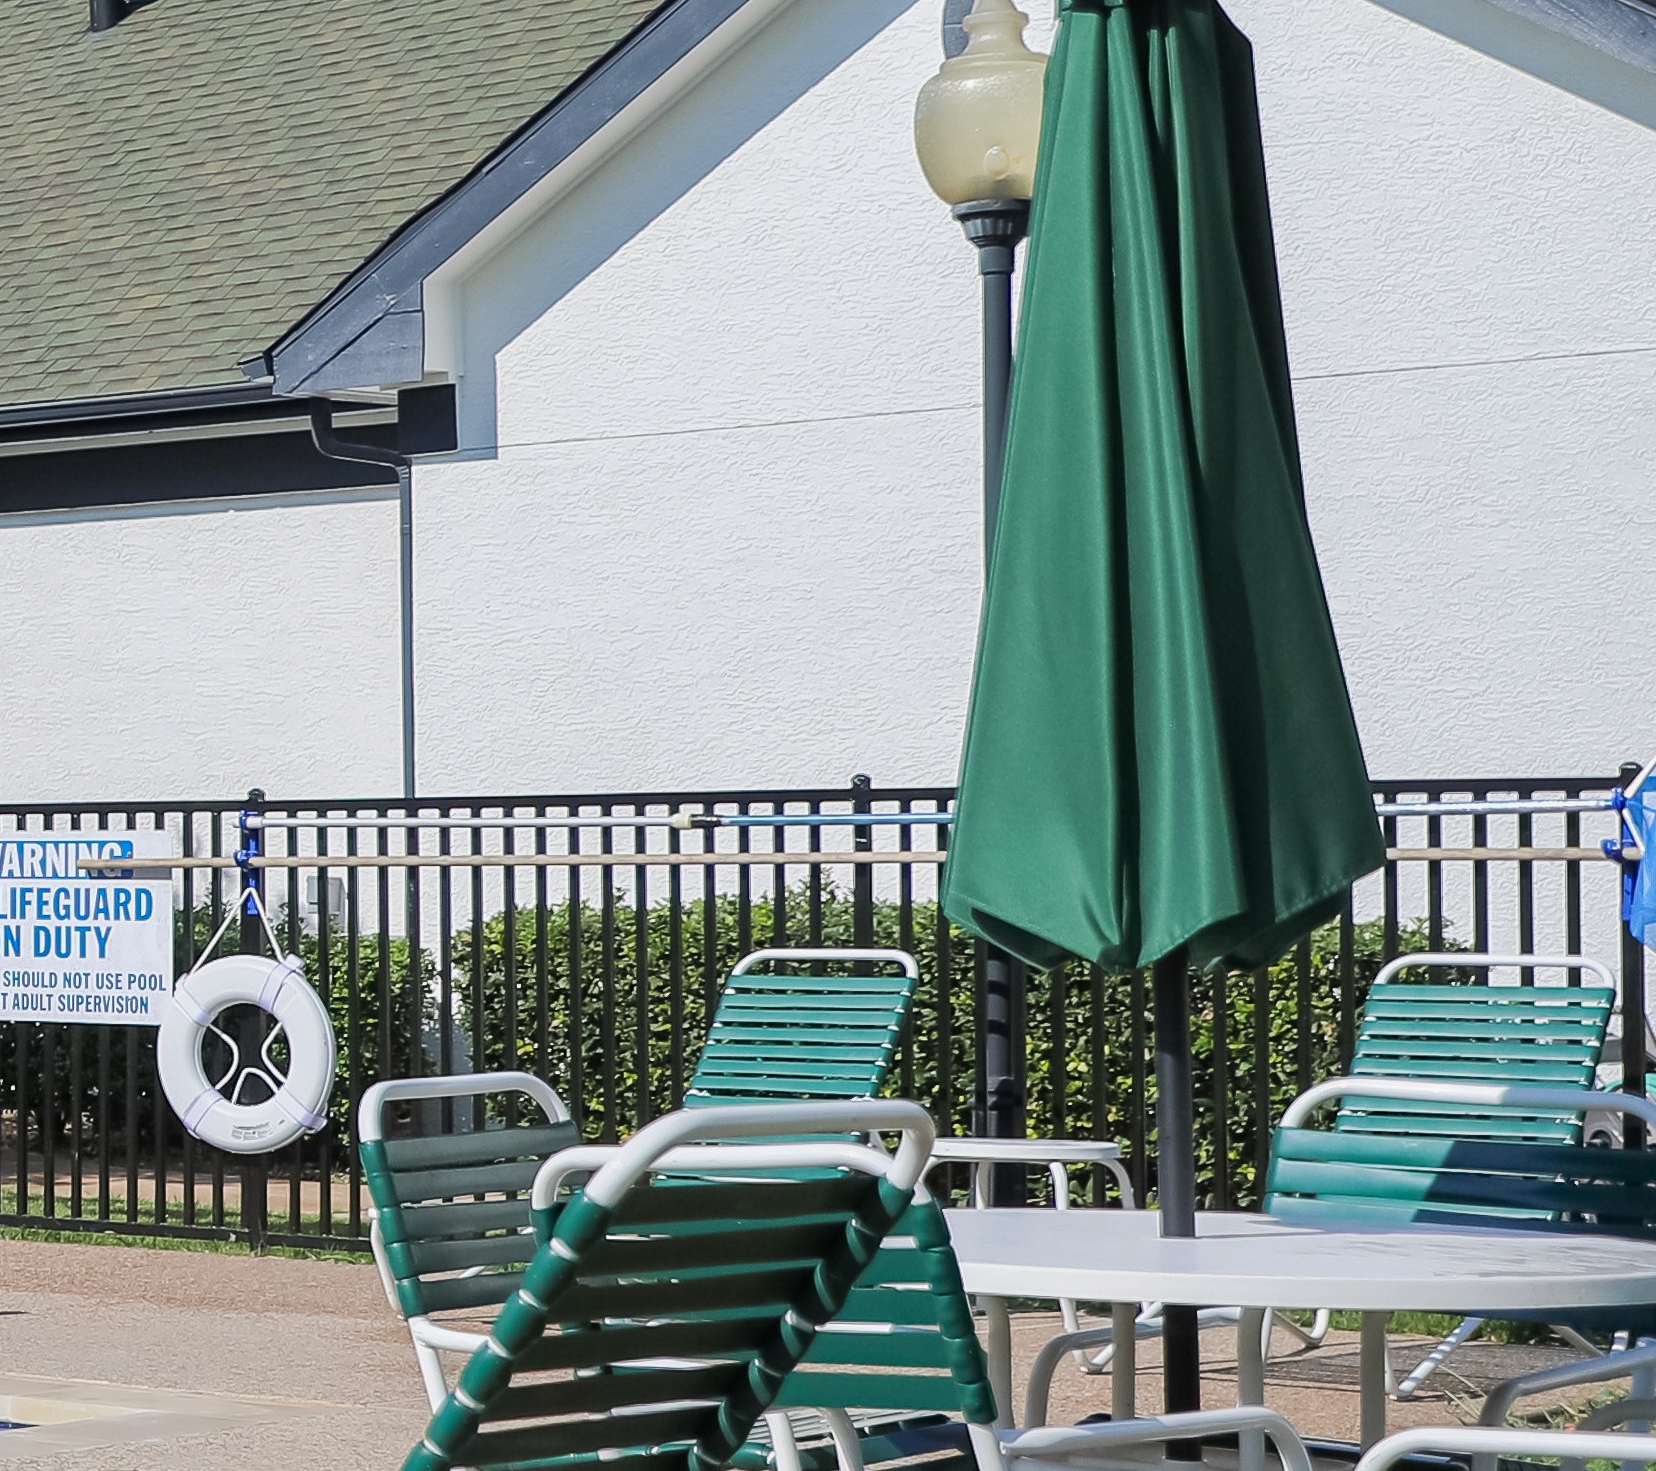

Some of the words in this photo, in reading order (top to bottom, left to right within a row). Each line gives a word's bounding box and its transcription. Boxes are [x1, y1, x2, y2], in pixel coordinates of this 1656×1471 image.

[33, 925, 113, 959] DUTY
[2, 971, 58, 989] SHOULD
[62, 972, 91, 990] NOT
[95, 973, 123, 991] USE
[127, 973, 167, 992] POOL
[11, 992, 54, 1012] ADULT
[57, 994, 150, 1015] SUPERVISION
